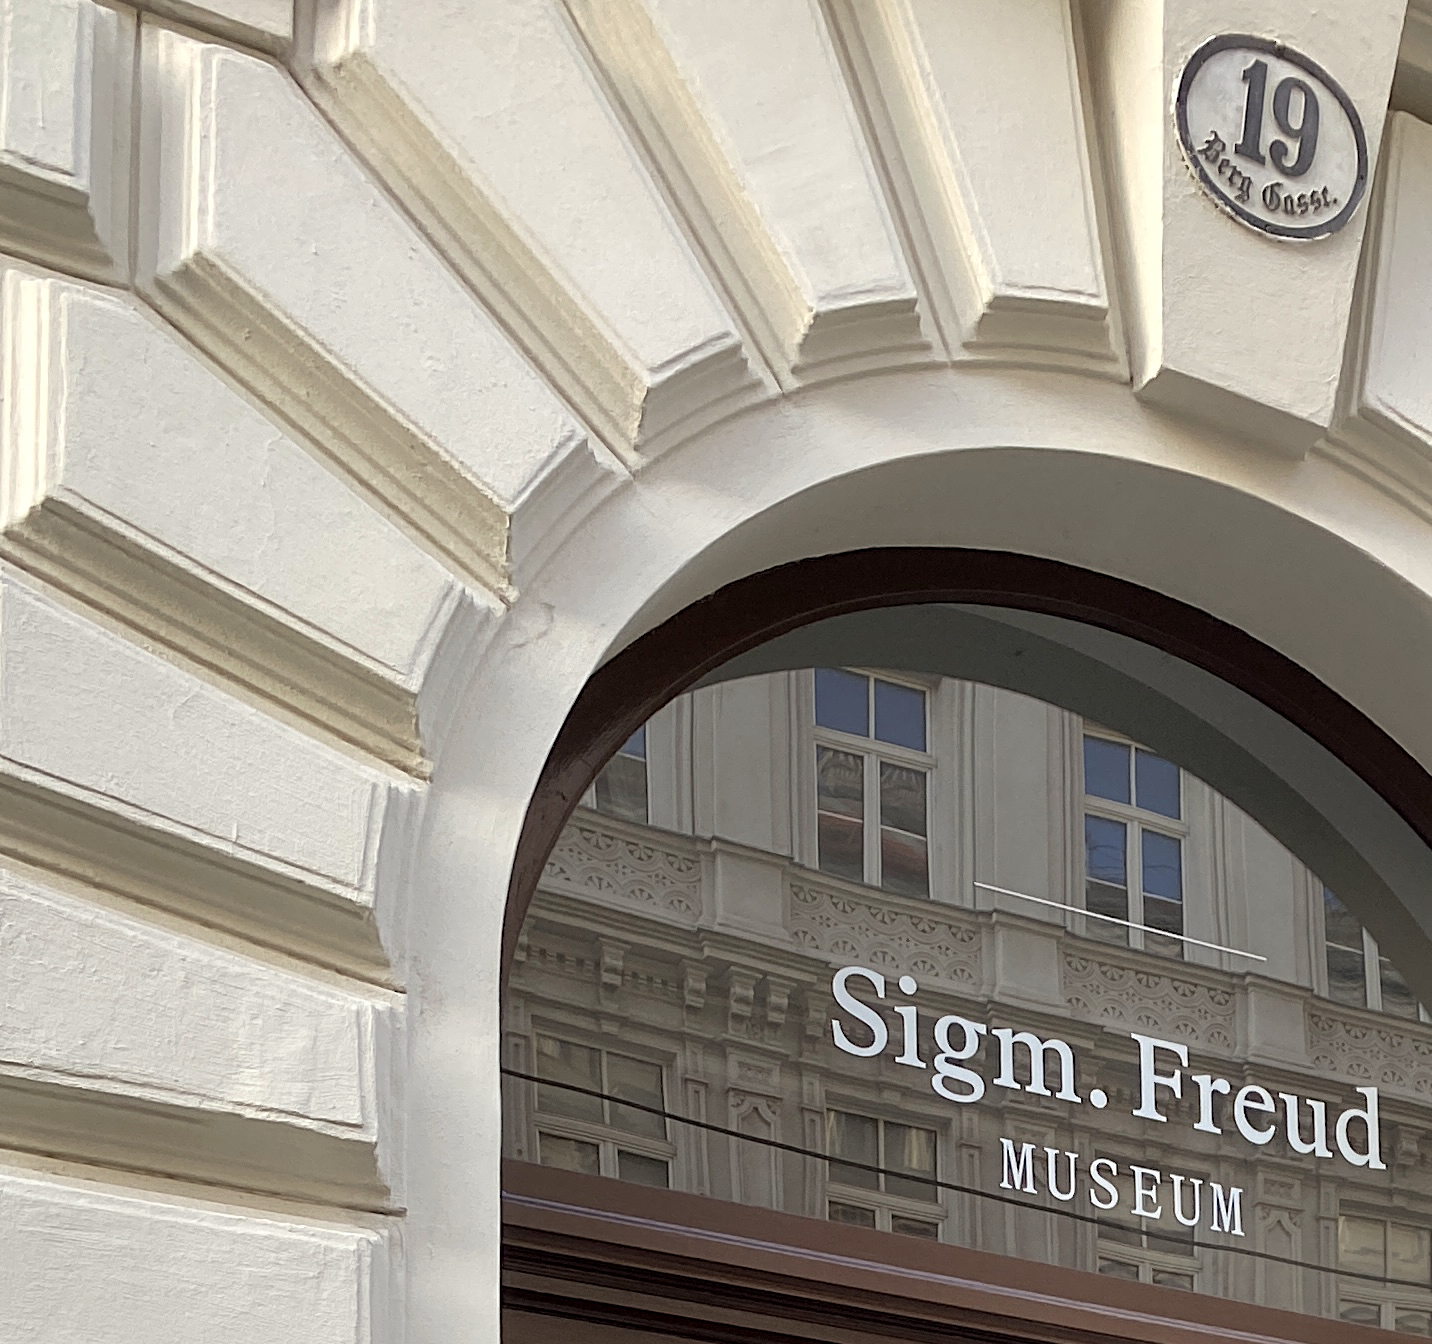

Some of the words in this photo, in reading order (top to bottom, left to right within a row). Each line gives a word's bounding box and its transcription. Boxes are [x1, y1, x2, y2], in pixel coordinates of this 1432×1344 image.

[1197, 130, 1253, 203] Berg
[1234, 58, 1320, 177] 19
[830, 965, 1109, 1109] Sigm.
[1131, 1032, 1387, 1171] Freud
[1000, 1137, 1246, 1237] MUSEUM
